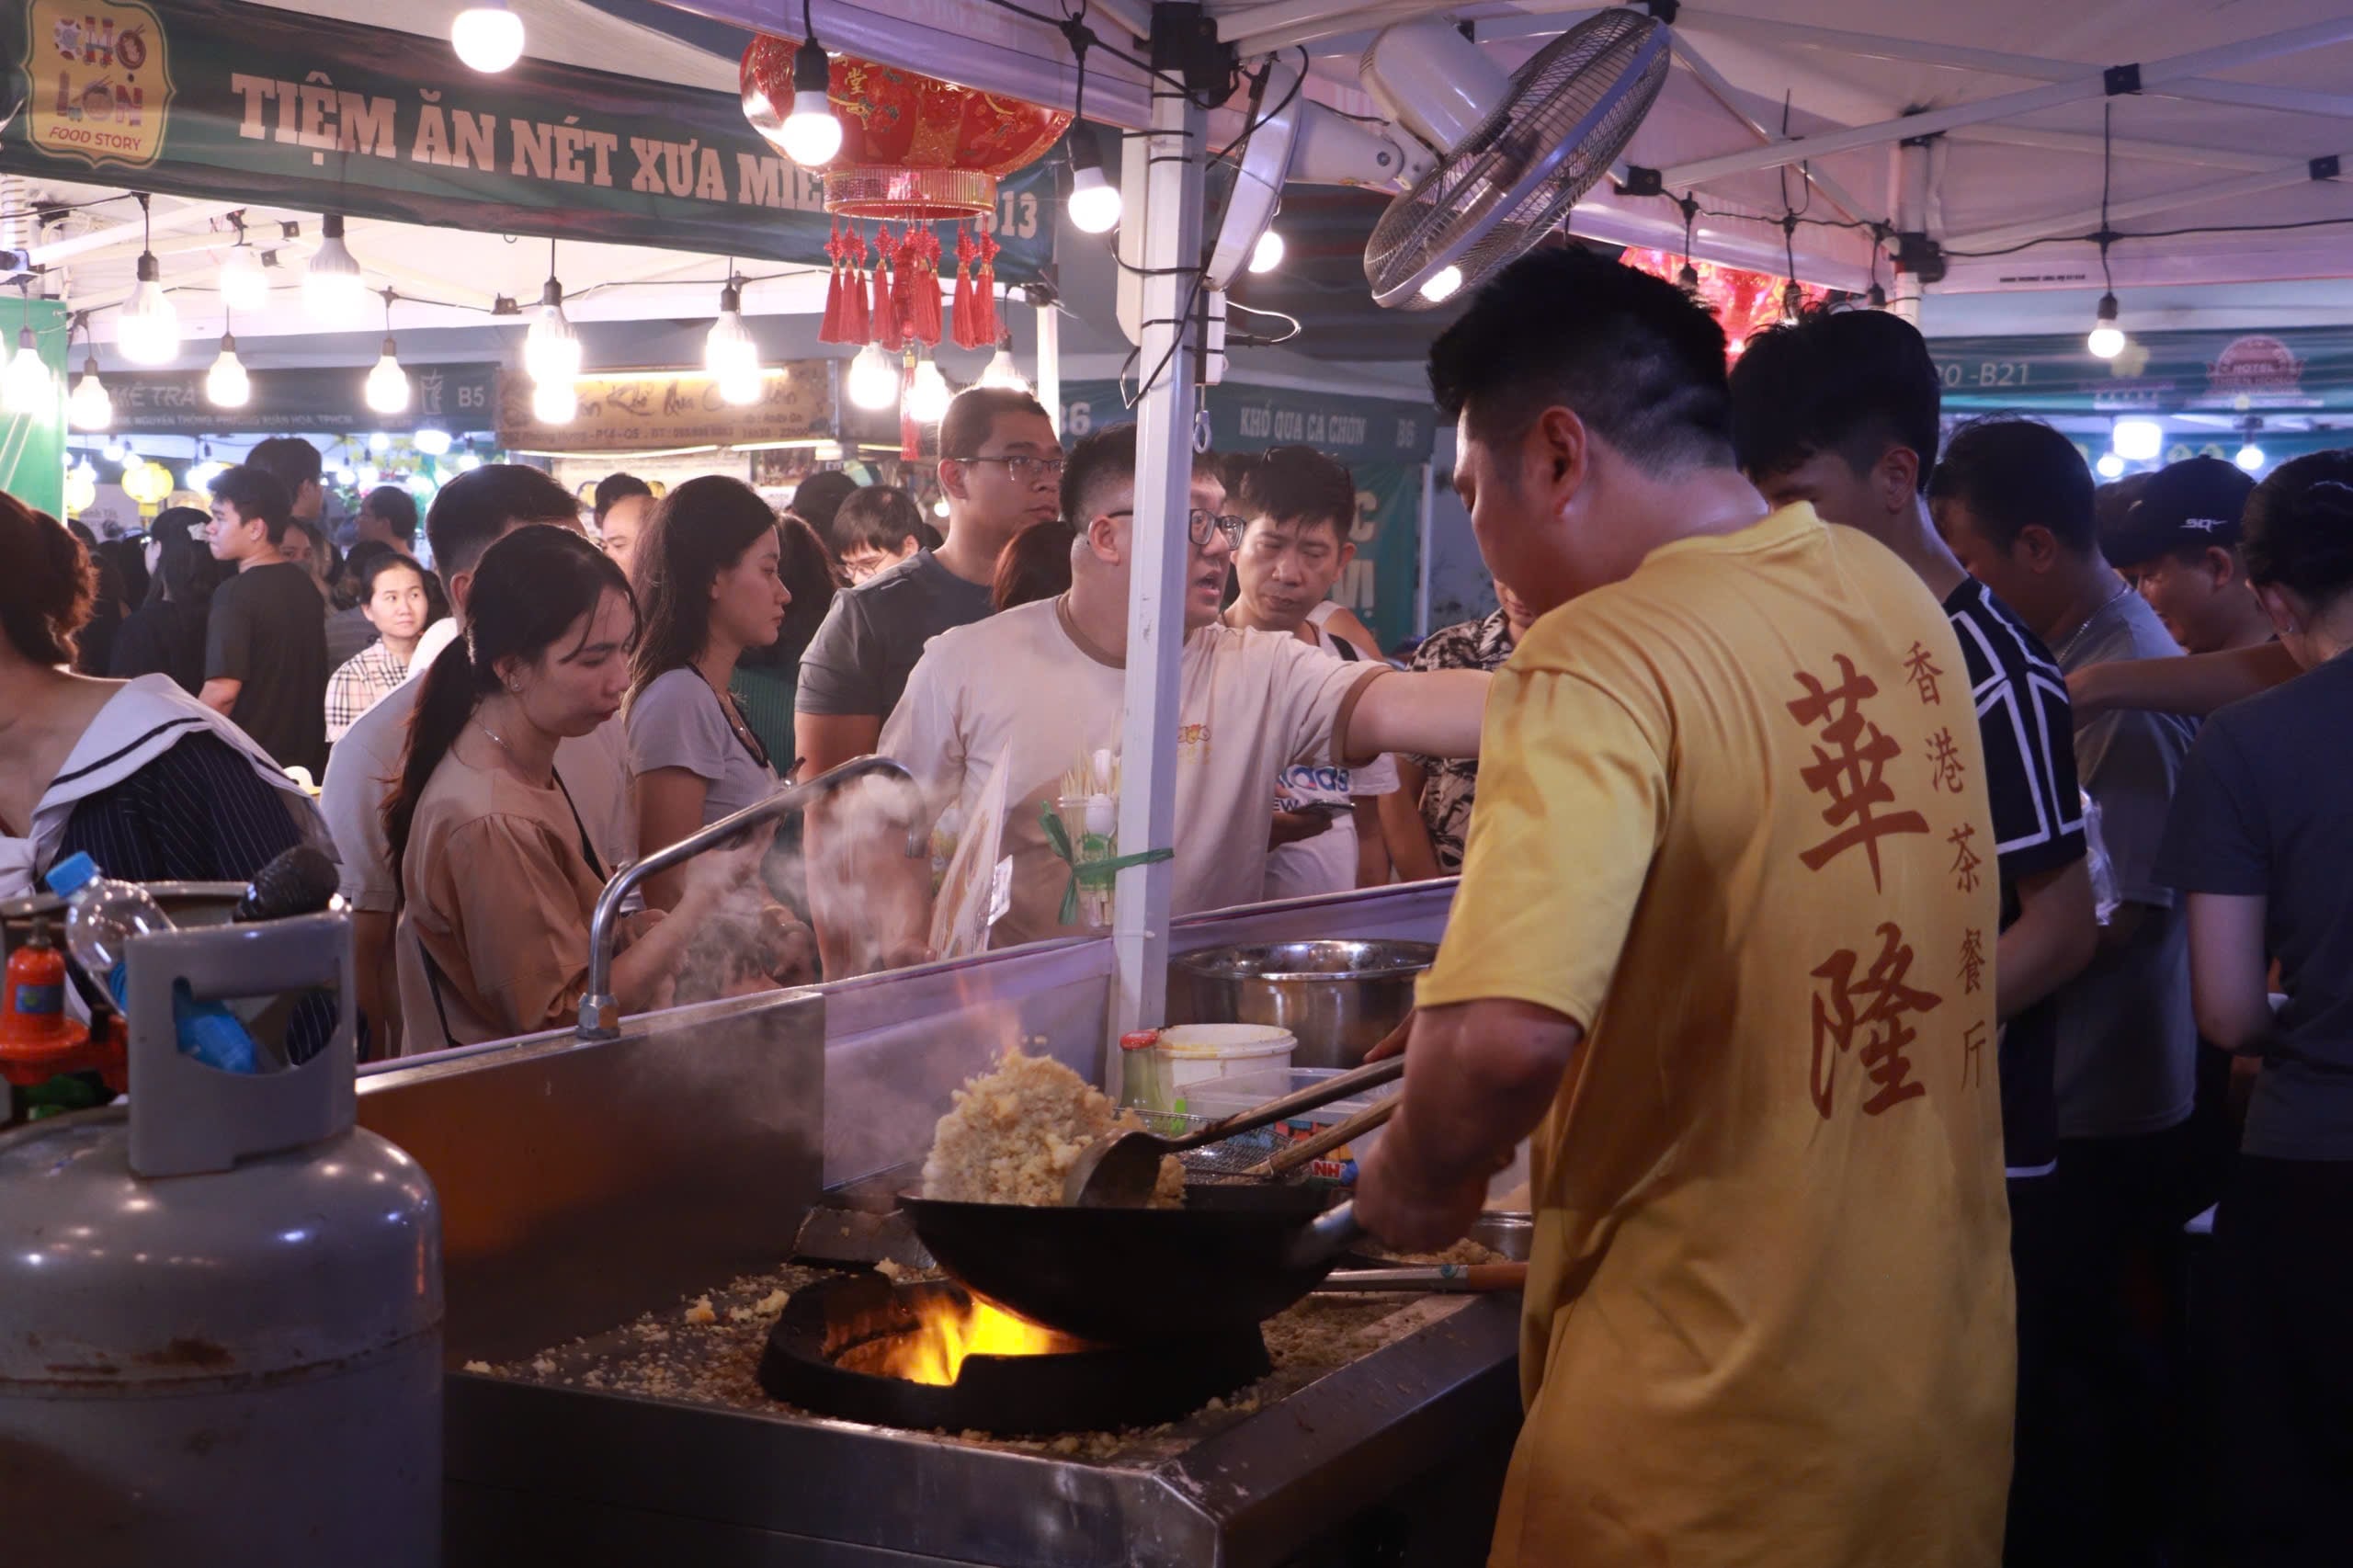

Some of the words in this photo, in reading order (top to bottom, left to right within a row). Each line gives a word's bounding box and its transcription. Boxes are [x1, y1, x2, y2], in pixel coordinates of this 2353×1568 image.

[50, 126, 91, 143] FOOD
[95, 132, 142, 151] STORY
[232, 71, 396, 165] TIỆM
[412, 88, 496, 172] ĂN
[510, 116, 618, 187] NÉT
[630, 137, 727, 201] XƯA
[459, 386, 484, 407] B5
[1274, 411, 1302, 441] QUA
